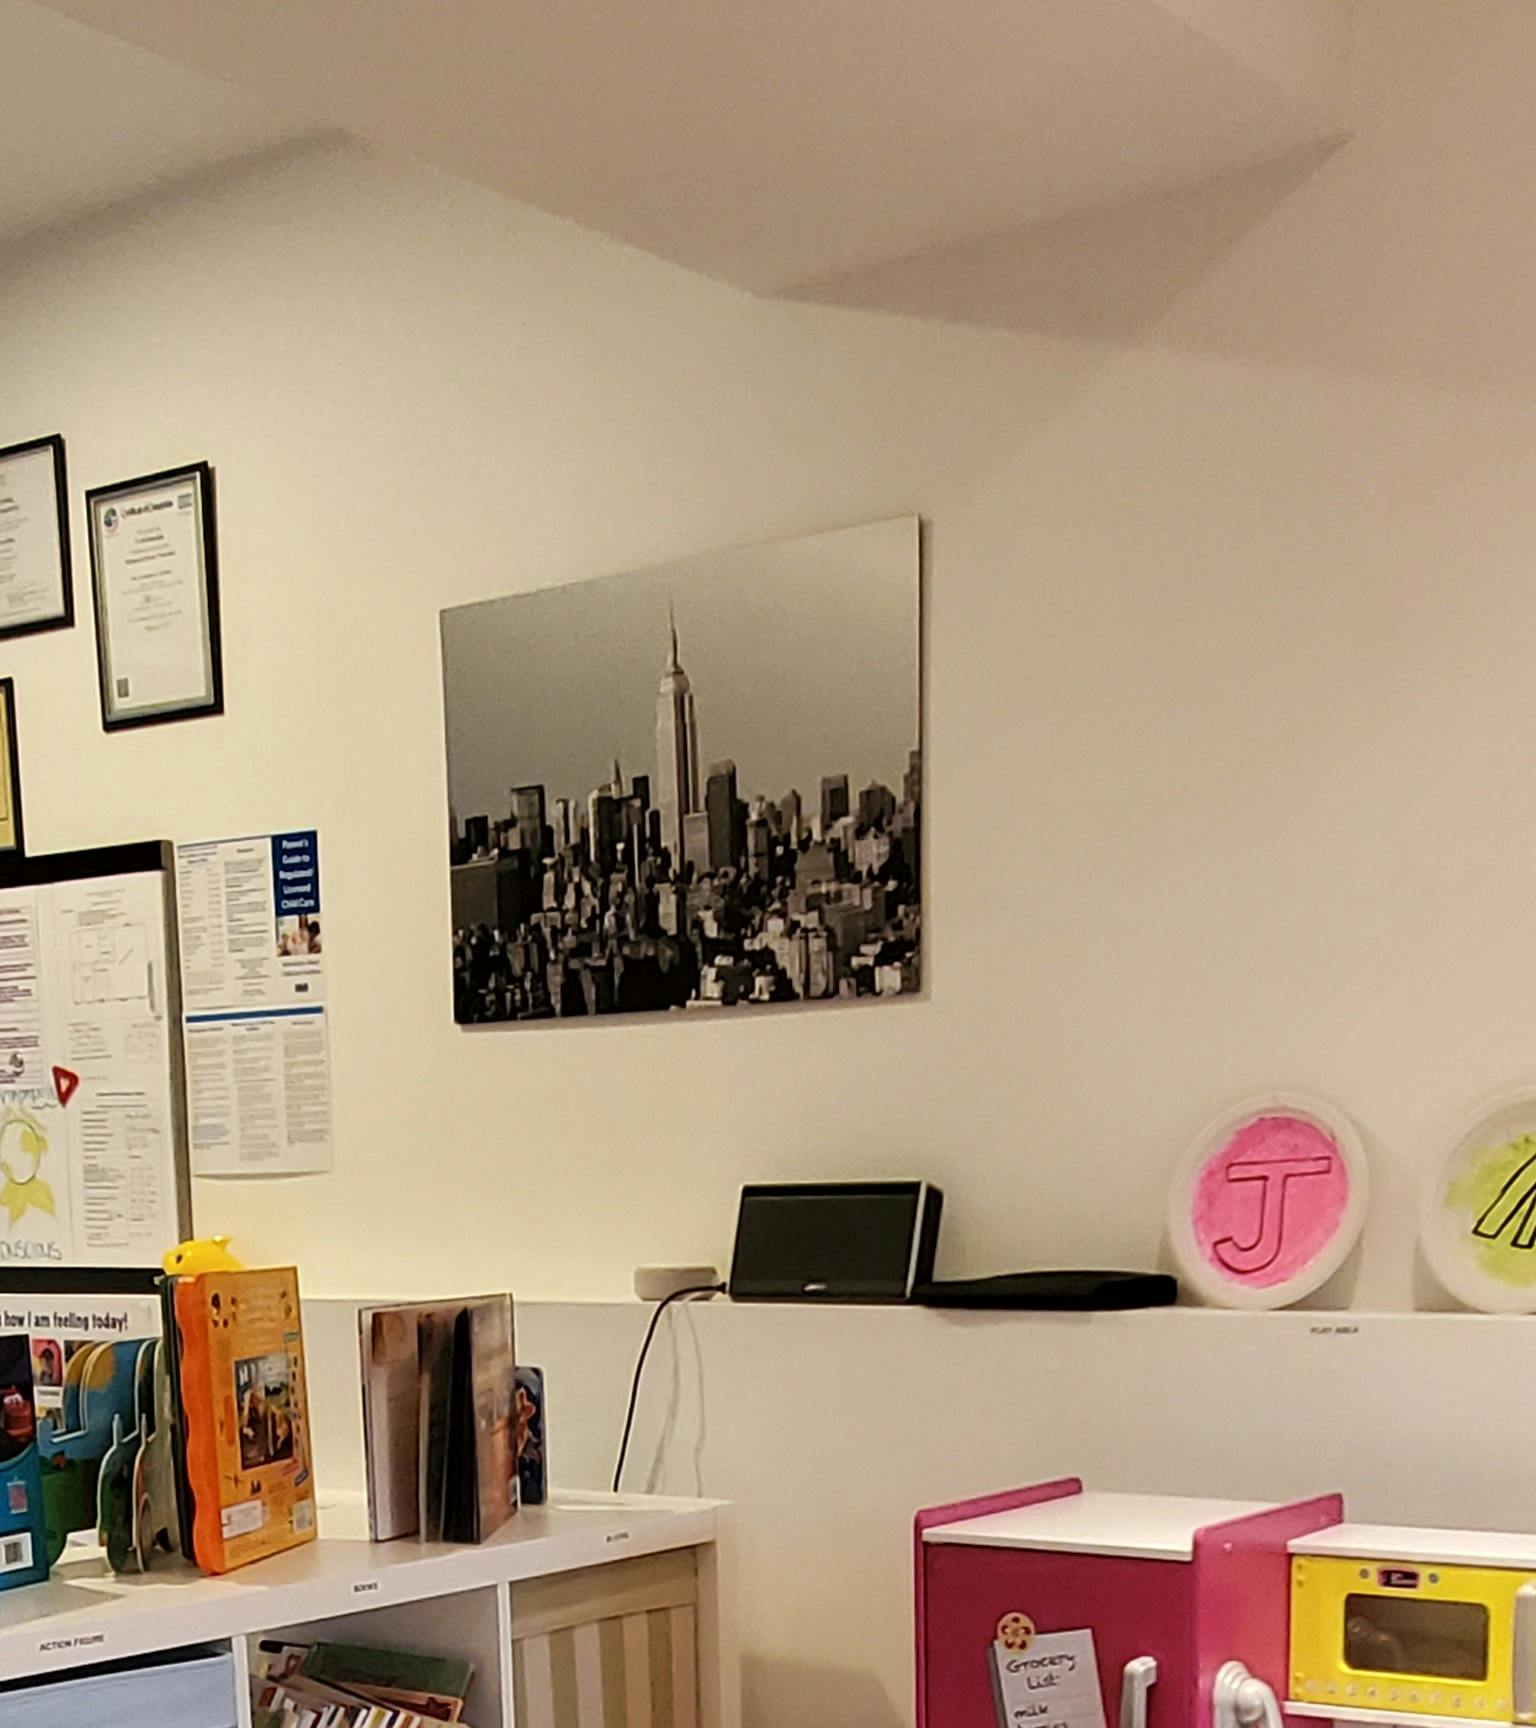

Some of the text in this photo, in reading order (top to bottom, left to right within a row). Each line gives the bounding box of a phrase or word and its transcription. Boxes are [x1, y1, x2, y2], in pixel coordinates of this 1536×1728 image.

[1213, 1157, 1331, 1274] J
[4, 1310, 25, 1327] how
[34, 1315, 50, 1327] am
[53, 1312, 89, 1331] feeling
[92, 1312, 128, 1332] today!
[1027, 1675, 1060, 1690] List
[1014, 1704, 1048, 1718] milk
